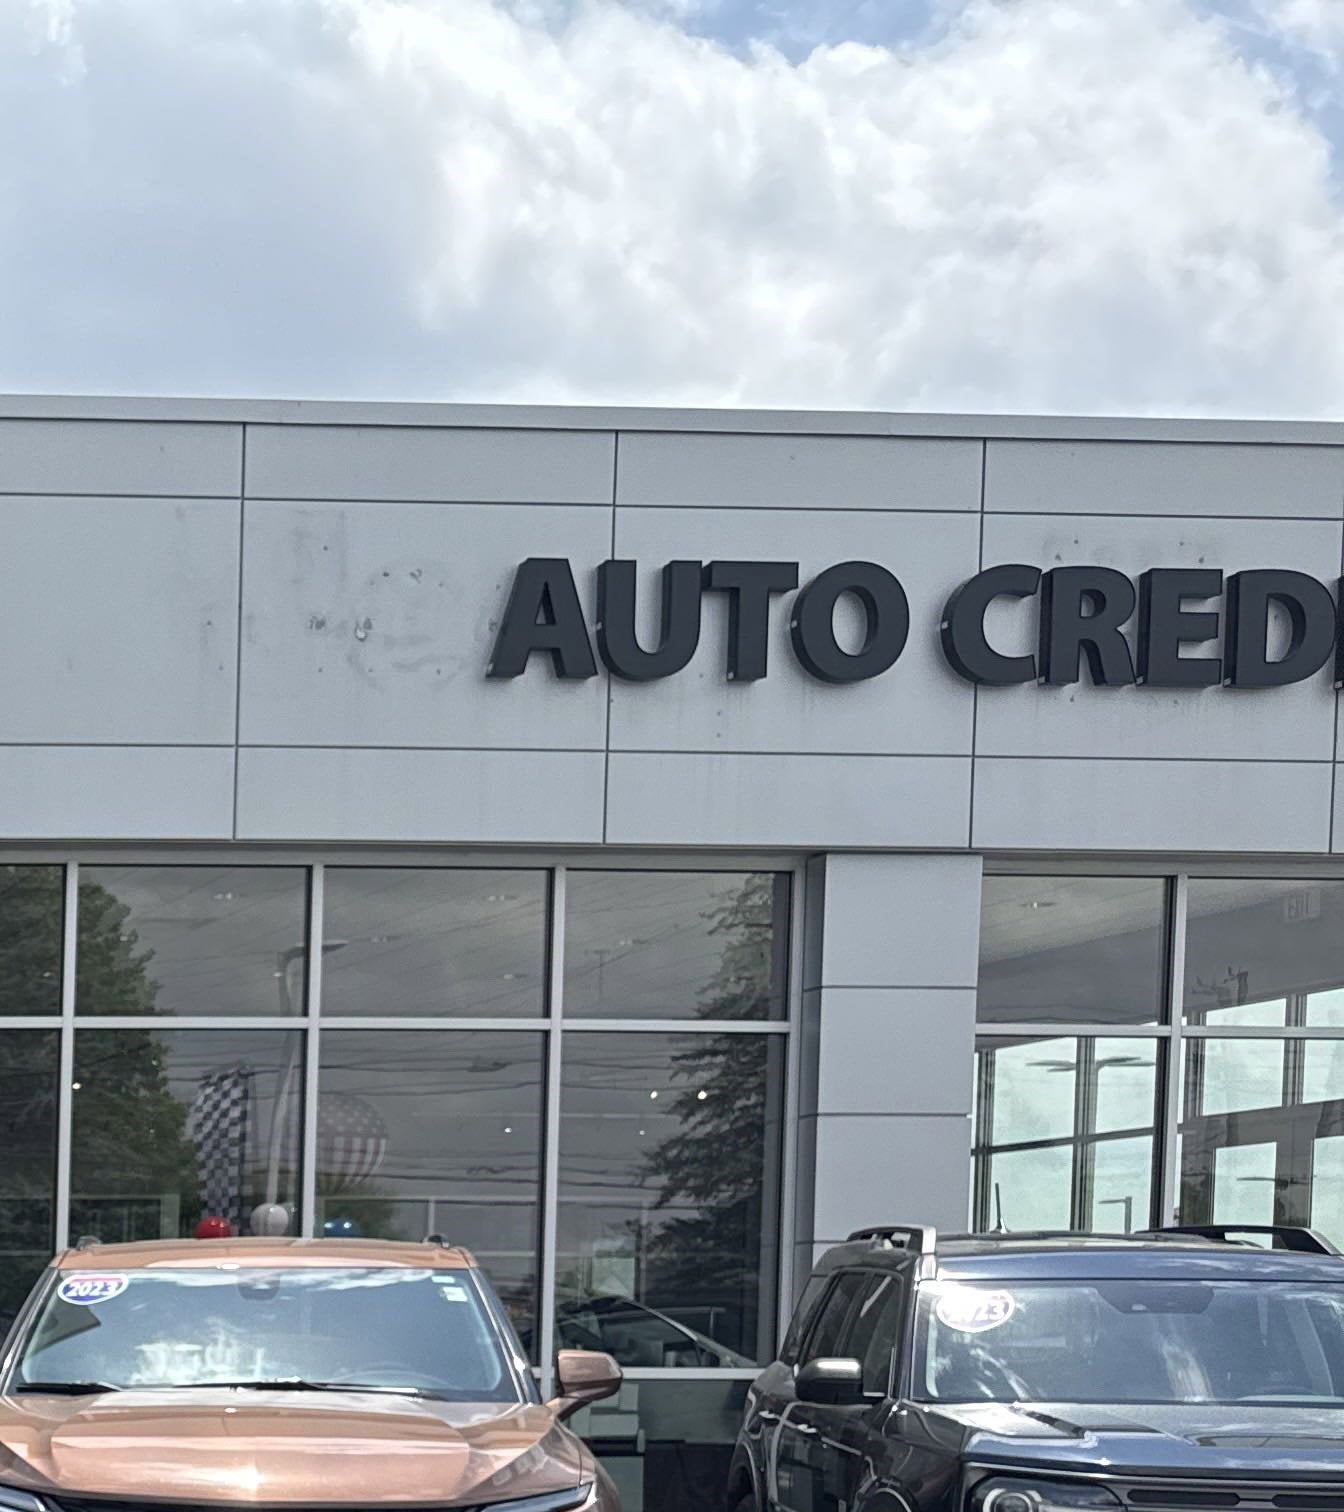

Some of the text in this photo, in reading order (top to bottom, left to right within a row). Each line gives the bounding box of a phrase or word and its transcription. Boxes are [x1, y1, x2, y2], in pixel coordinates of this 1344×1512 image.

[485, 557, 1344, 690] AUTO CRED
[65, 1280, 119, 1297] 2023
